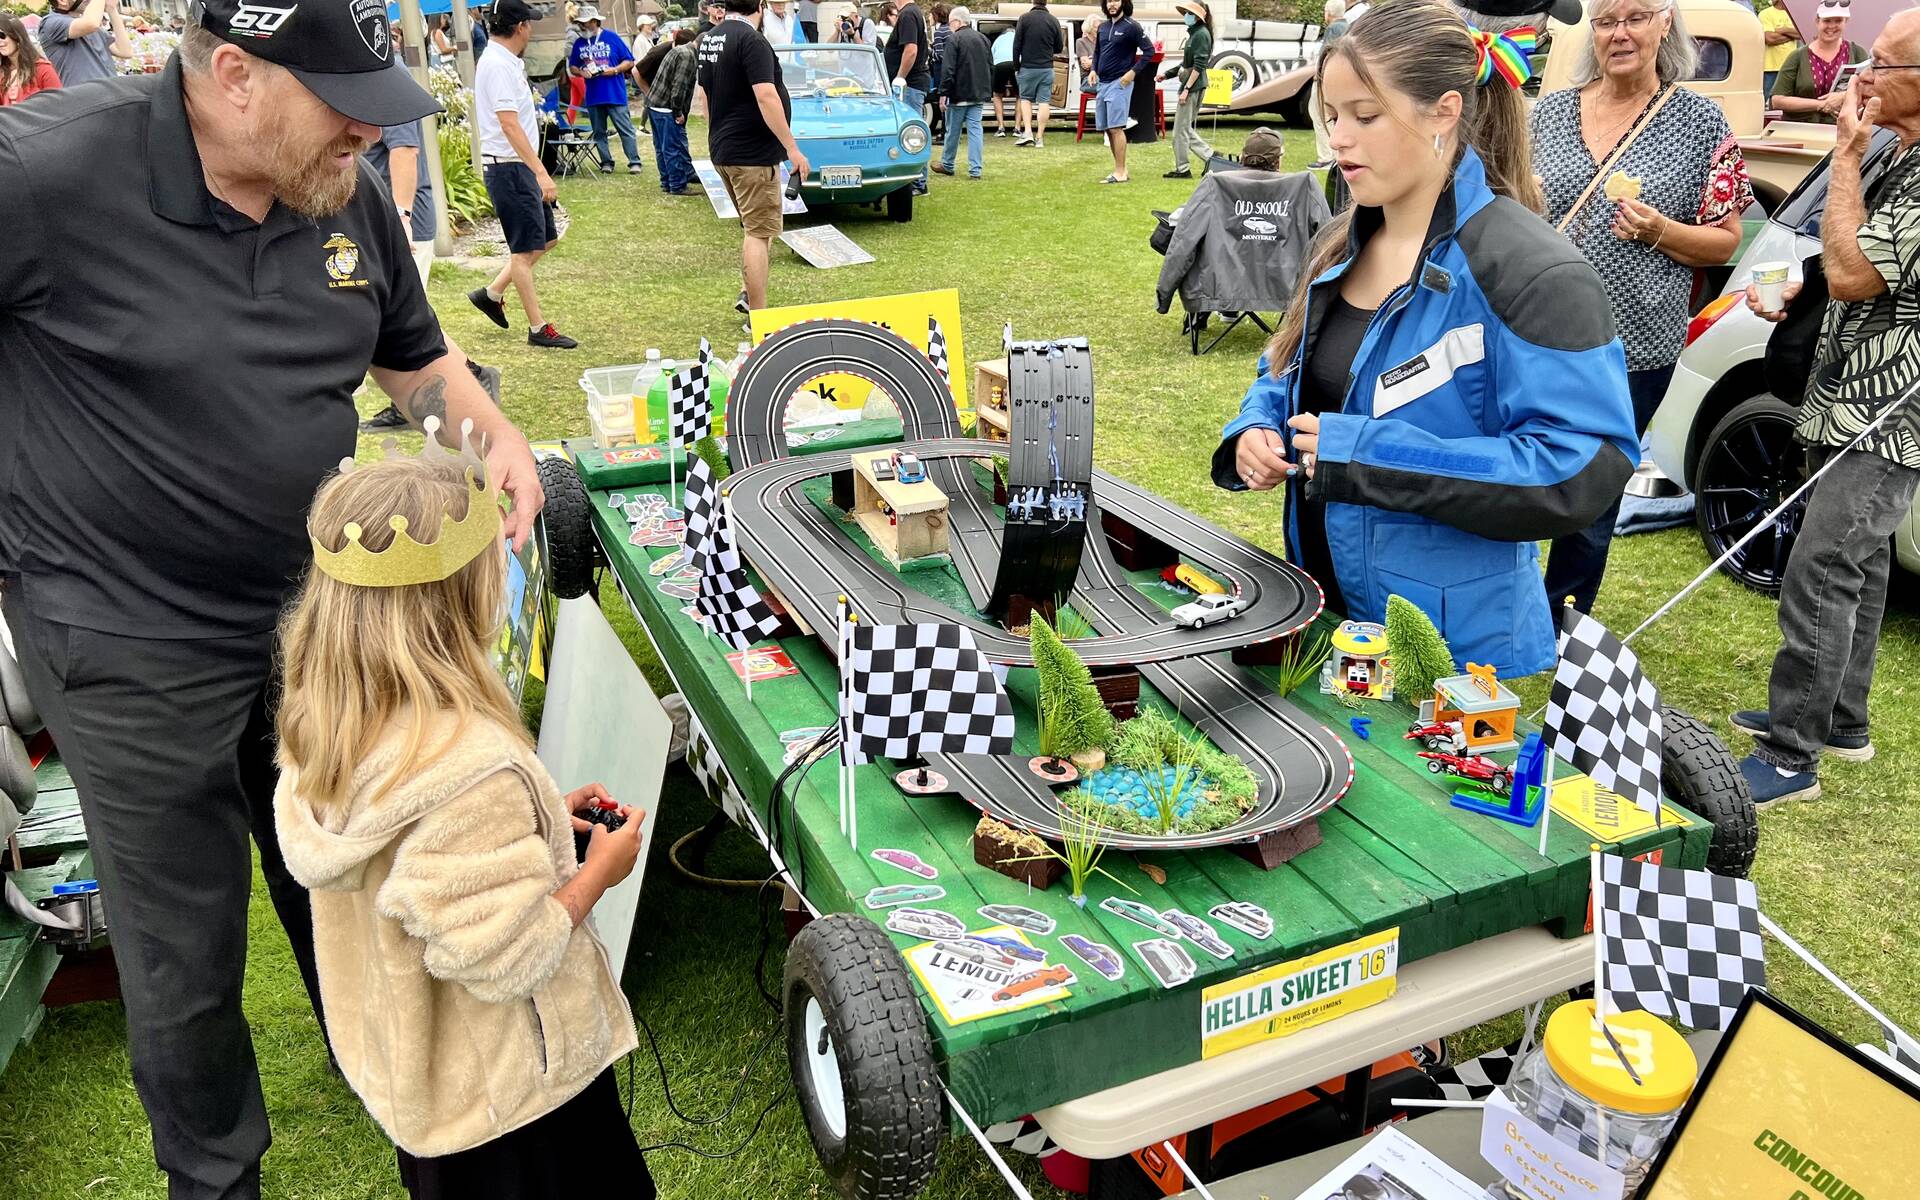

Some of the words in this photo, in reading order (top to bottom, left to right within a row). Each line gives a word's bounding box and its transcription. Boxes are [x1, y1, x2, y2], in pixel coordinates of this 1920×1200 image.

[579, 51, 611, 60] OKYEST
[822, 175, 828, 186] A
[831, 174, 852, 186] BOAT
[855, 174, 861, 185] 2
[1235, 199, 1254, 216] OLD
[1254, 200, 1290, 217] SKOOLZ
[1206, 986, 1273, 1032] HELLA
[1281, 959, 1352, 1007] SWEET
[1292, 1009, 1311, 1021] HOURS
[1320, 999, 1342, 1011] LEMONS
[1554, 1161, 1600, 1192] Cancer
